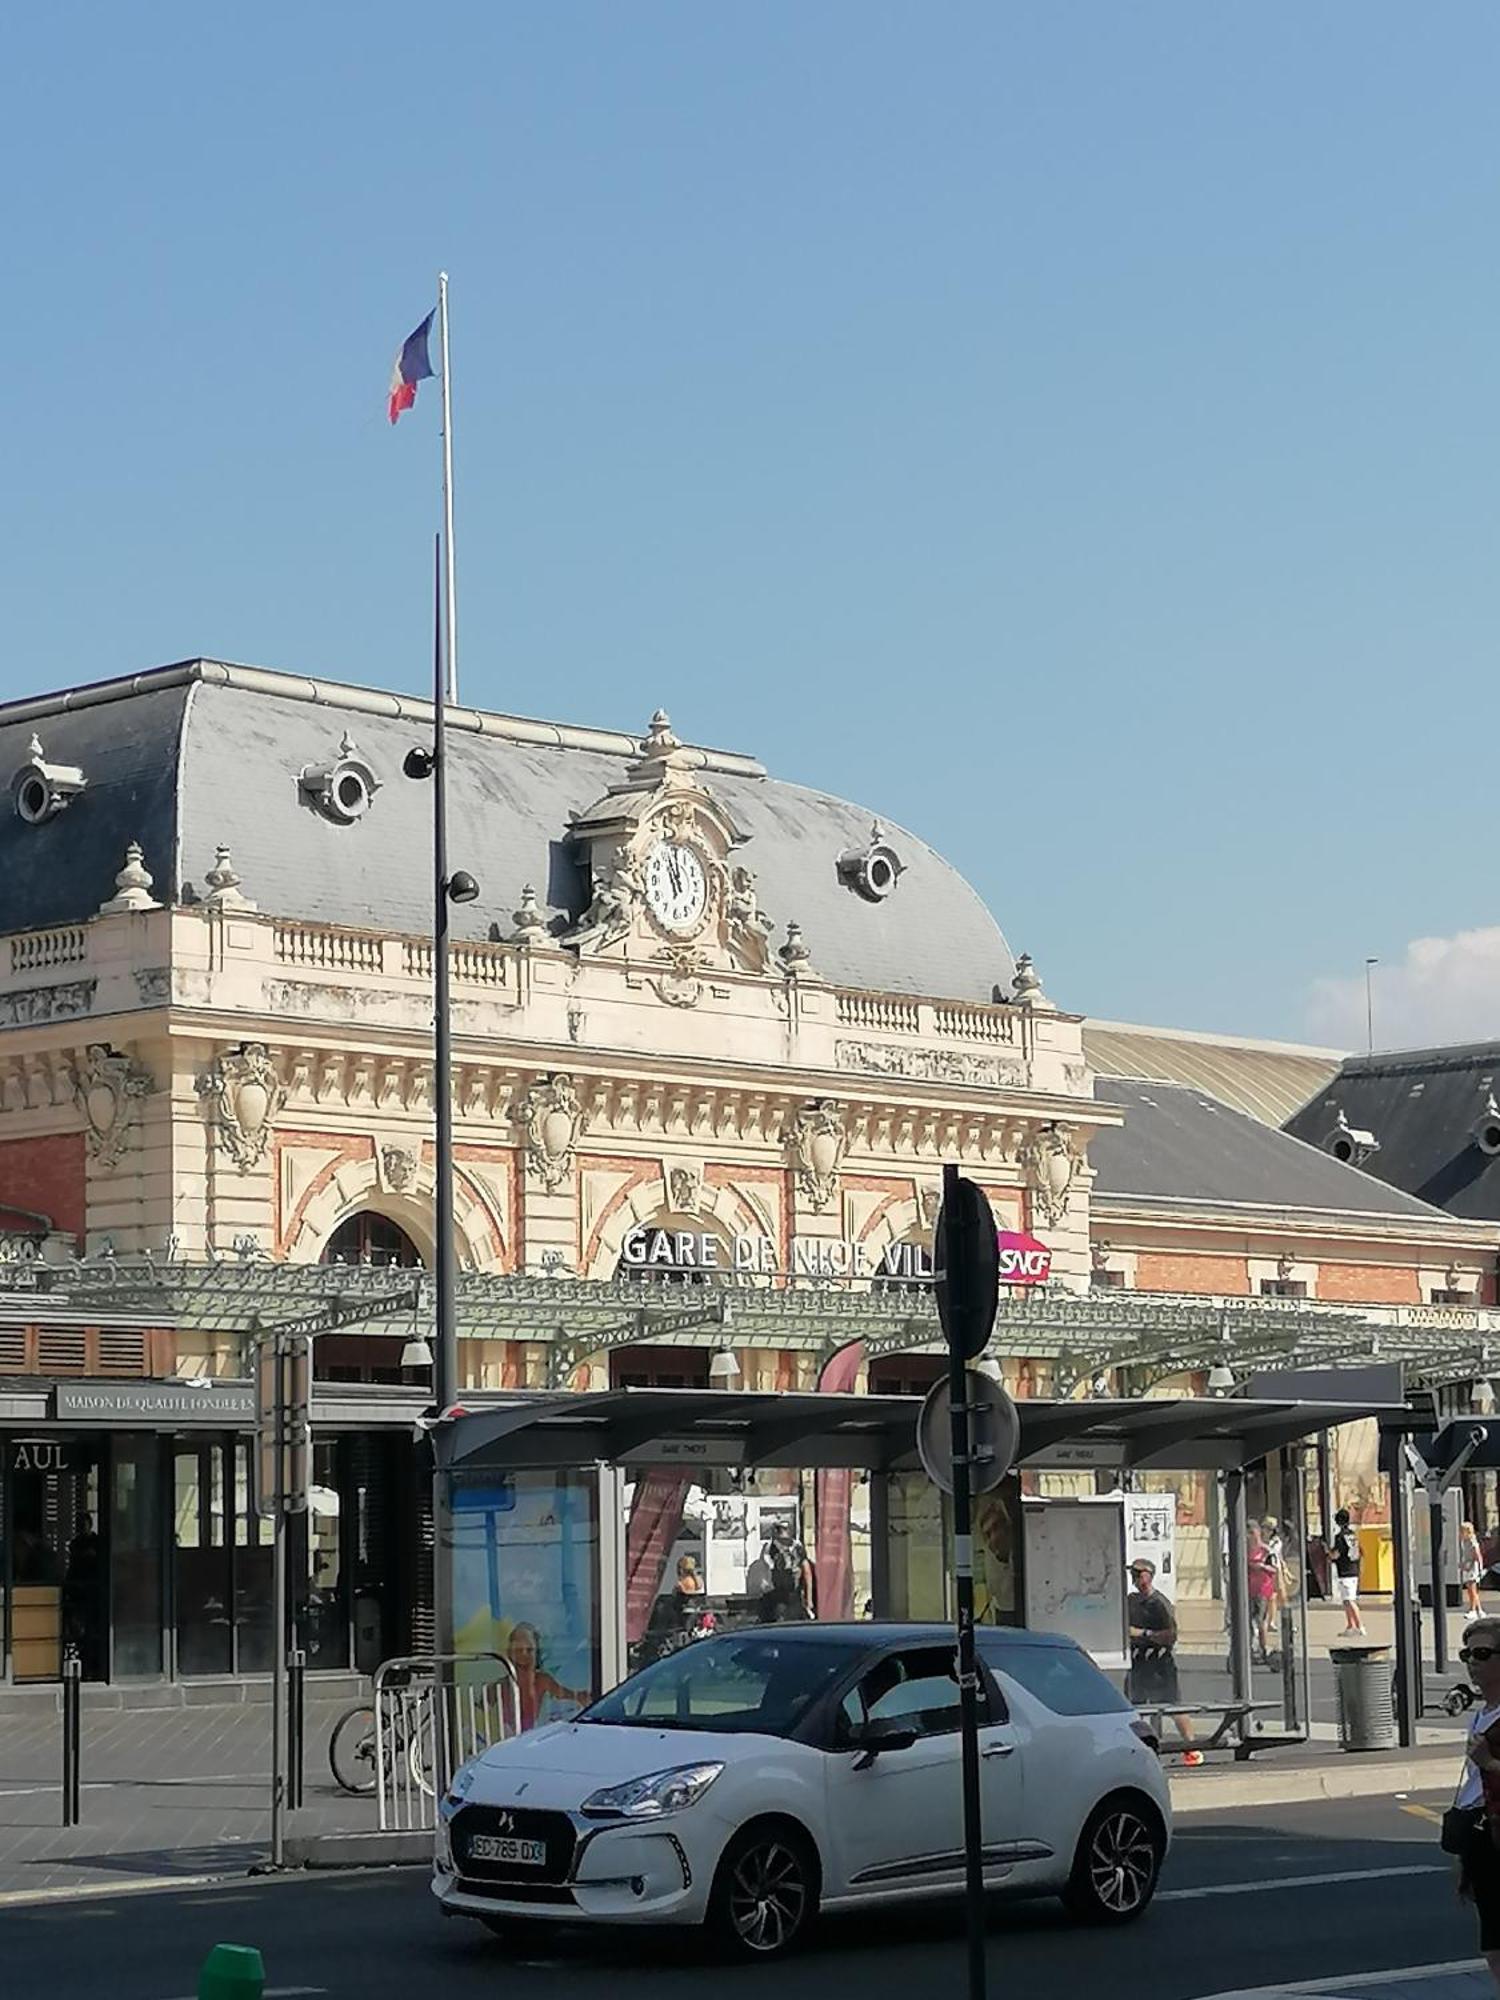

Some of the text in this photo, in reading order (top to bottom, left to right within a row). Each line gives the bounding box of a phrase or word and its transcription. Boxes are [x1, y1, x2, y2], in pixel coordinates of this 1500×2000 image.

[623, 1228, 932, 1277] GARE DE NICE VIL
[998, 1248, 1051, 1276] SNCF
